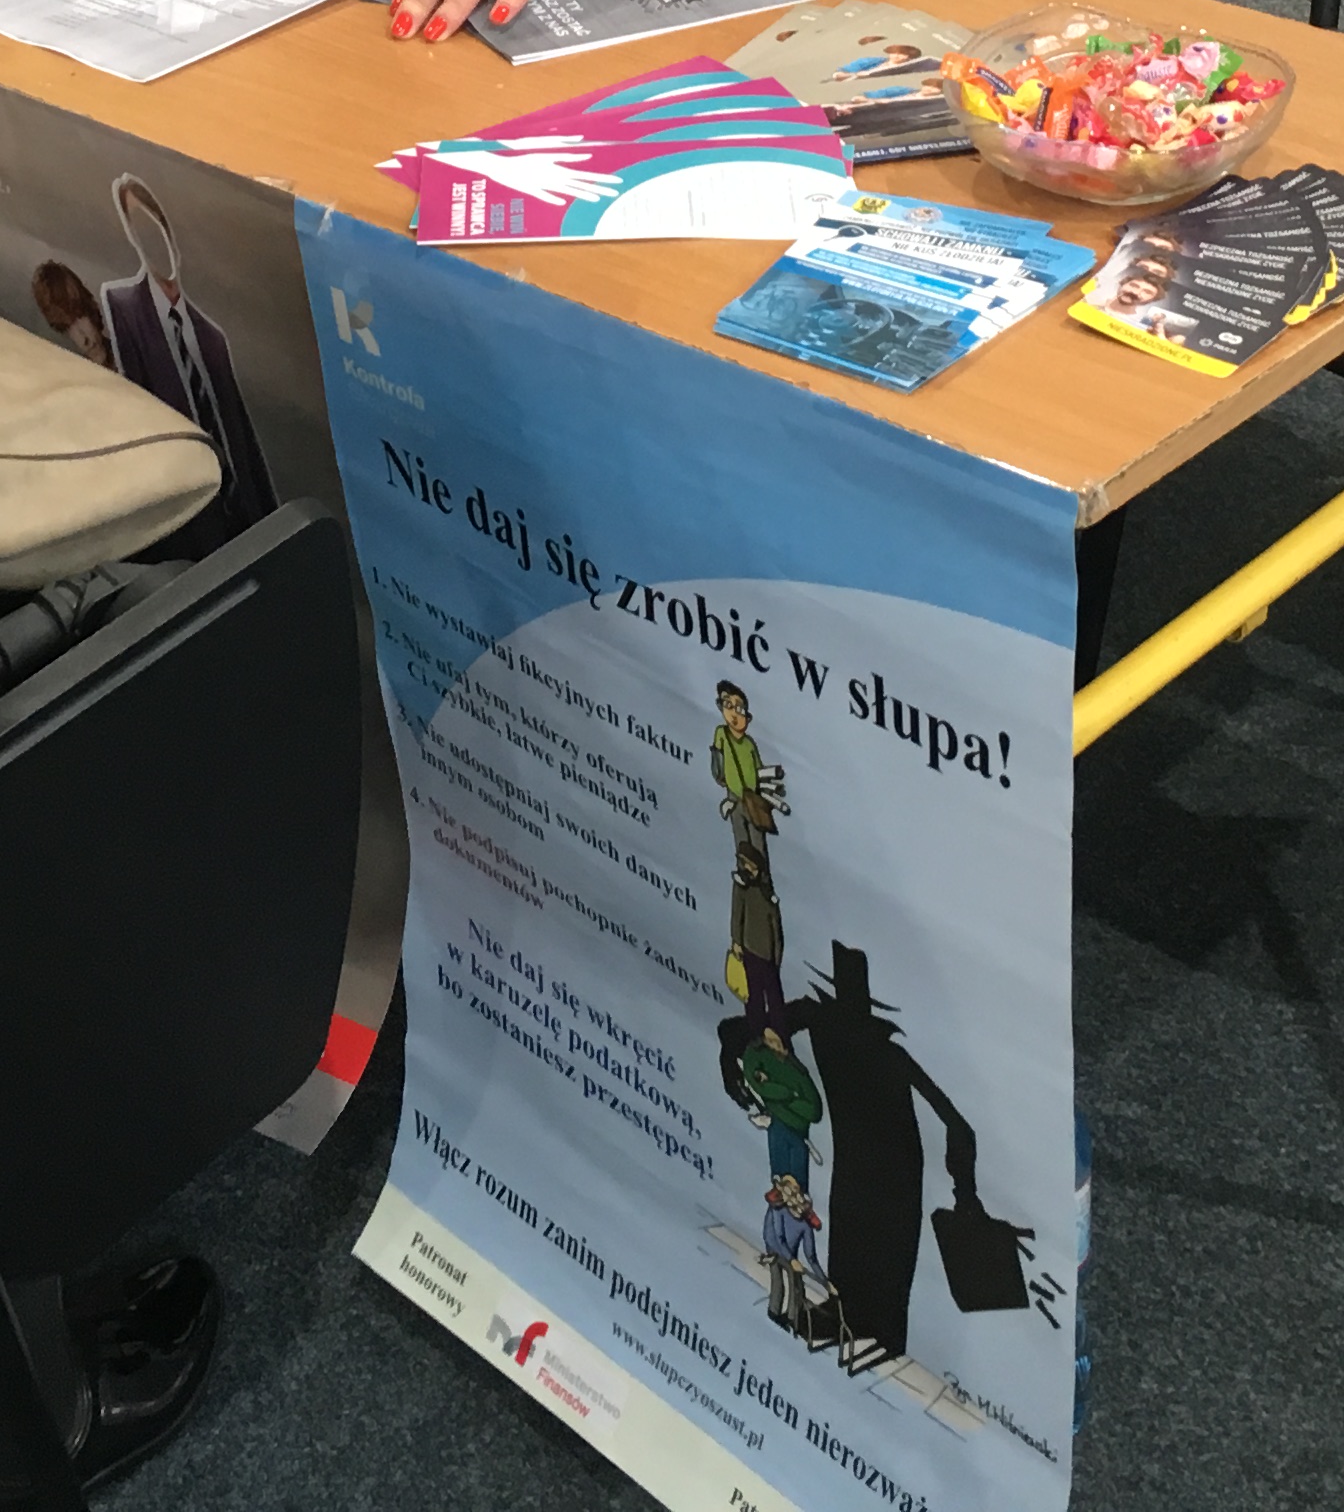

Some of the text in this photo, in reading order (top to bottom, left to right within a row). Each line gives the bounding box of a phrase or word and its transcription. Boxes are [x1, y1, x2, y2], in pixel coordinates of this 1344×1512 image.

[343, 356, 425, 411] Kontrola
[373, 566, 694, 765] 1. Nie wystawiaj fikcyjnych faktur
[380, 438, 1011, 789] Nie daj się zrobić w słupa!
[383, 620, 659, 811] 2. Nie ufaj tym, którzy oferują
[407, 660, 651, 828] Ci szybkie, łatwe pieniądze
[421, 746, 545, 841] innym osobom
[397, 702, 697, 911] 3. Nie udostępniaj swoich danych
[433, 828, 544, 910] dokumentów
[410, 786, 725, 1006] 4. Nie podpisuj pochopnie żadnych
[438, 963, 714, 1181] bo zostaniesz przestępcą!
[447, 942, 702, 1141] w karuzelę podatkową,
[468, 918, 676, 1082] Nie daj się wkręcić
[399, 1254, 465, 1318] honorowy
[410, 1231, 469, 1286] Patronat
[414, 1108, 471, 1178] Włącz
[475, 1165, 538, 1229] rozum
[543, 1217, 605, 1281] zanim
[609, 1269, 732, 1378] podejmiesz
[734, 1359, 799, 1431] jeden
[536, 1366, 591, 1418] Finansów
[543, 1350, 621, 1420] Ministerstwo
